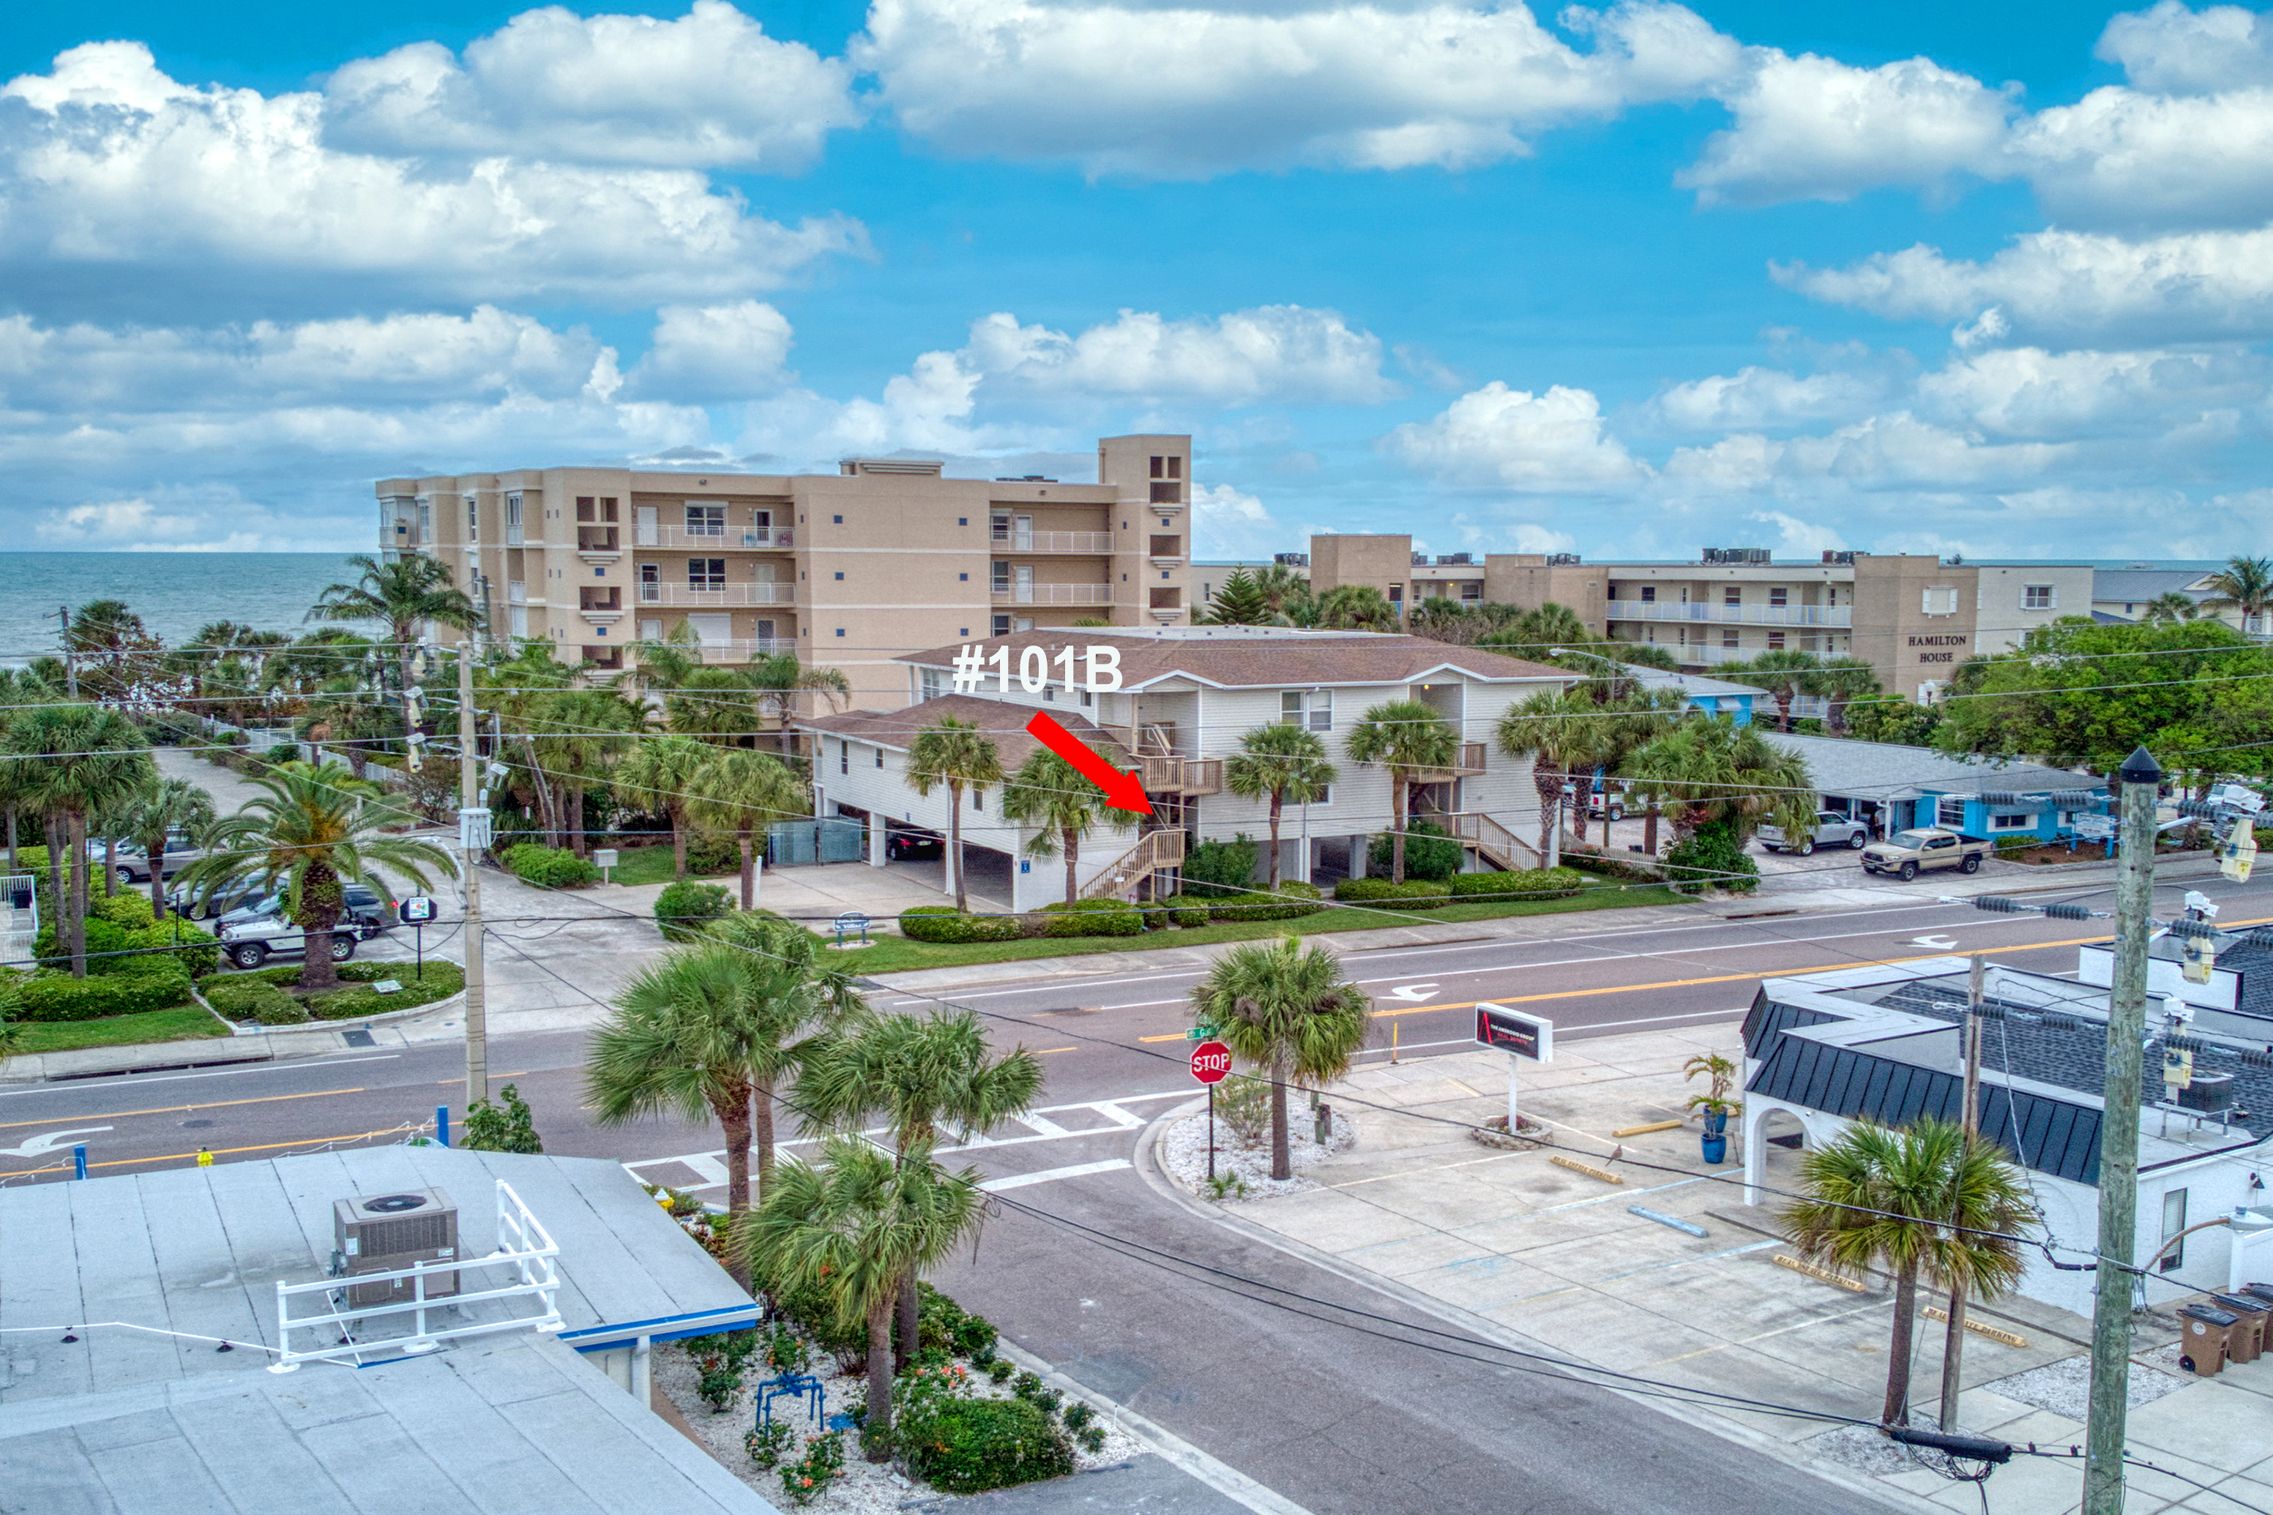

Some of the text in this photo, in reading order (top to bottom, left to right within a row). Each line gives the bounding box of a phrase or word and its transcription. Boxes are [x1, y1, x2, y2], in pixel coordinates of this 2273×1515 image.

[1908, 635, 1967, 646] HAMILTON
[1920, 652, 1954, 663] HOUSE
[1193, 1053, 1229, 1072] STOP
[1982, 1326, 2018, 1343] PARKING
